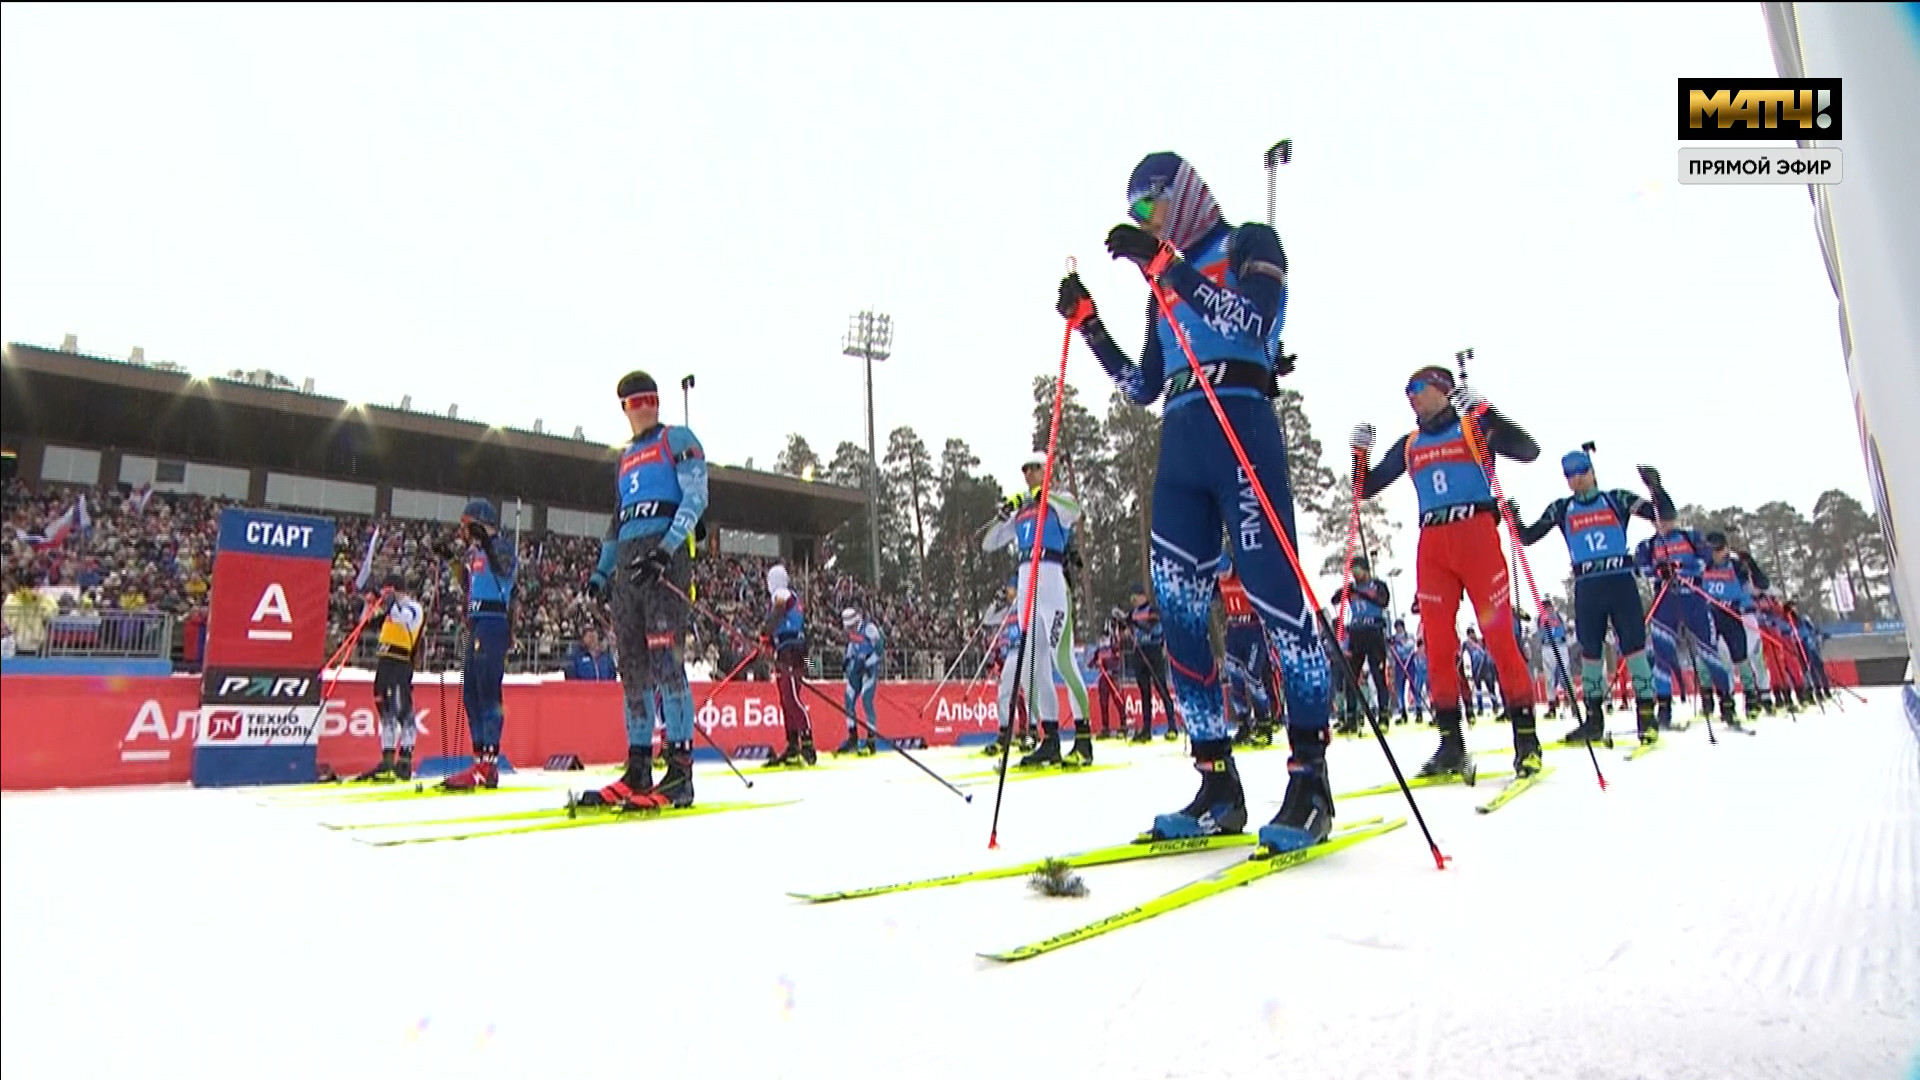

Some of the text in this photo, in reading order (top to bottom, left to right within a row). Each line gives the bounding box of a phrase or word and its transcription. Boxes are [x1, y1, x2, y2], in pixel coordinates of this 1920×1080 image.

[629, 470, 640, 494] 3
[1432, 469, 1448, 495] 8
[246, 521, 314, 548] СТАРТ
[1023, 521, 1031, 542] 7
[1584, 530, 1607, 553] 12
[1708, 582, 1725, 594] 20
[219, 677, 310, 697] PARI
[247, 714, 300, 725] ТЕХНО
[321, 700, 431, 736] Бак
[935, 697, 999, 727] Альфа
